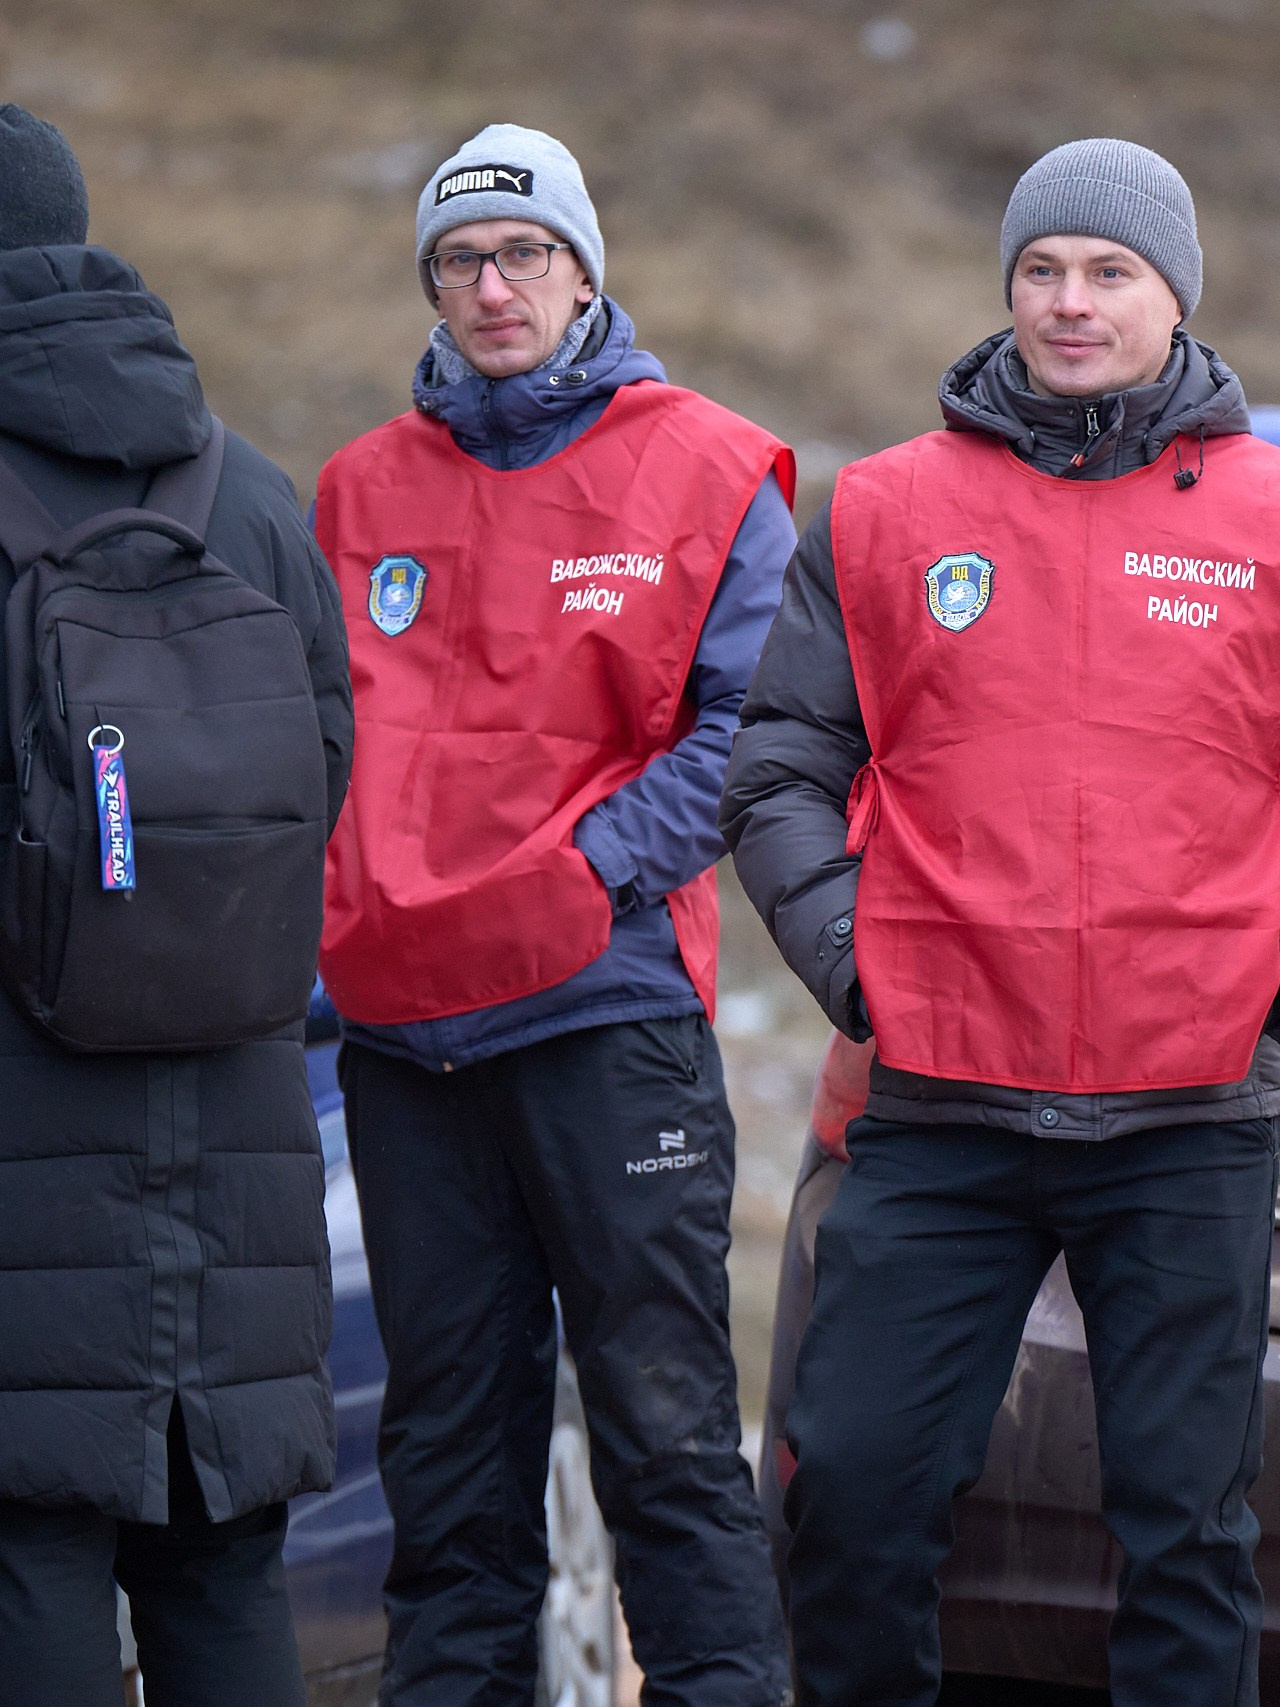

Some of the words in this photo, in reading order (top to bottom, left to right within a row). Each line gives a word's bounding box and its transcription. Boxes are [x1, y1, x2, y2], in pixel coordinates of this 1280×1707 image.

[439, 170, 495, 200] PUMA
[550, 553, 664, 586] ВАВОЖСКИЙ
[951, 565, 969, 581] НД
[1124, 551, 1256, 590] ВАВОЖСКИЙ
[561, 582, 624, 616] РАЙОН
[1147, 594, 1218, 628] РАЙОН
[106, 788, 126, 883] TRAILHEAD
